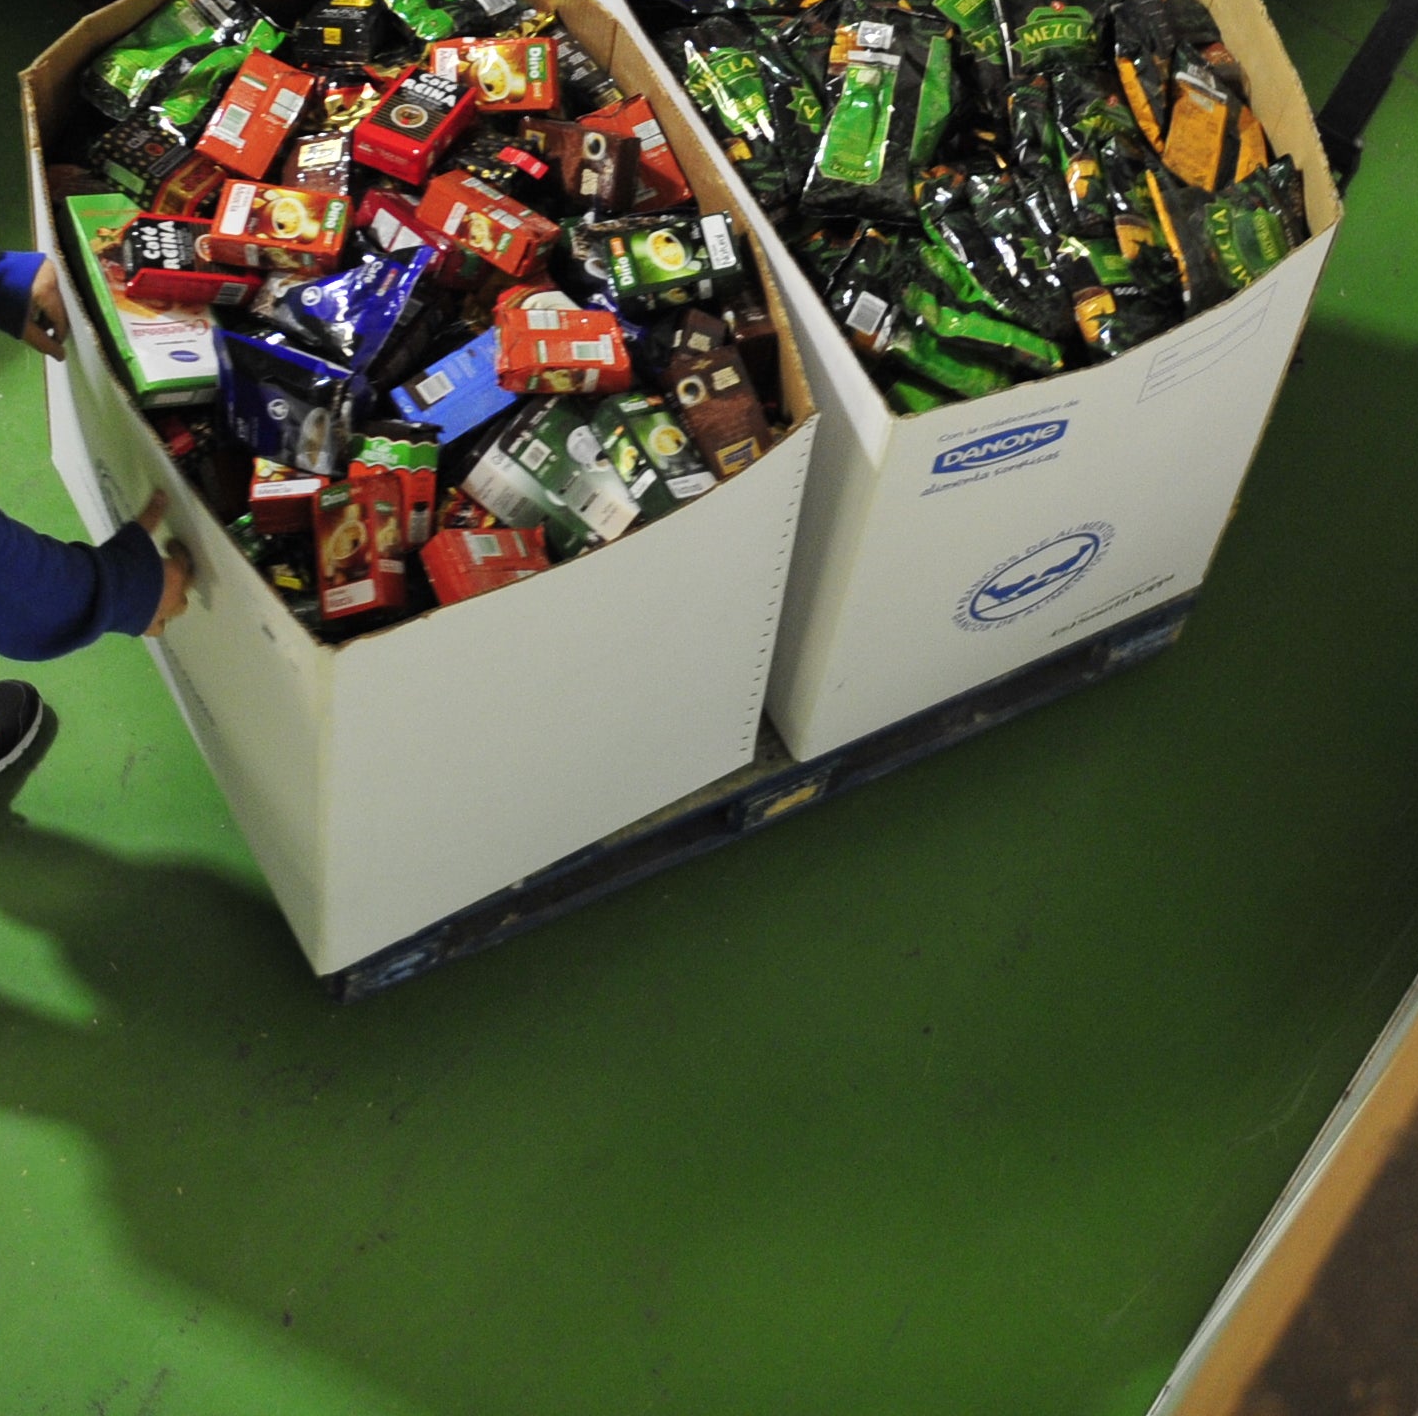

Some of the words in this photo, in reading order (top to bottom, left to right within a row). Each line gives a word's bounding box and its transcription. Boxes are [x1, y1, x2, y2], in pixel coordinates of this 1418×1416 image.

[529, 46, 541, 79] Dino
[419, 73, 457, 92] Café
[329, 200, 344, 230] Dino
[142, 225, 160, 260] Café
[619, 255, 636, 286] Dino
[937, 431, 964, 443] Con
[980, 405, 1061, 432] colaboración
[1063, 399, 1080, 407] de
[941, 423, 1061, 468] DANONE
[961, 555, 1019, 605] BANCOS
[1026, 538, 1050, 555] DE
